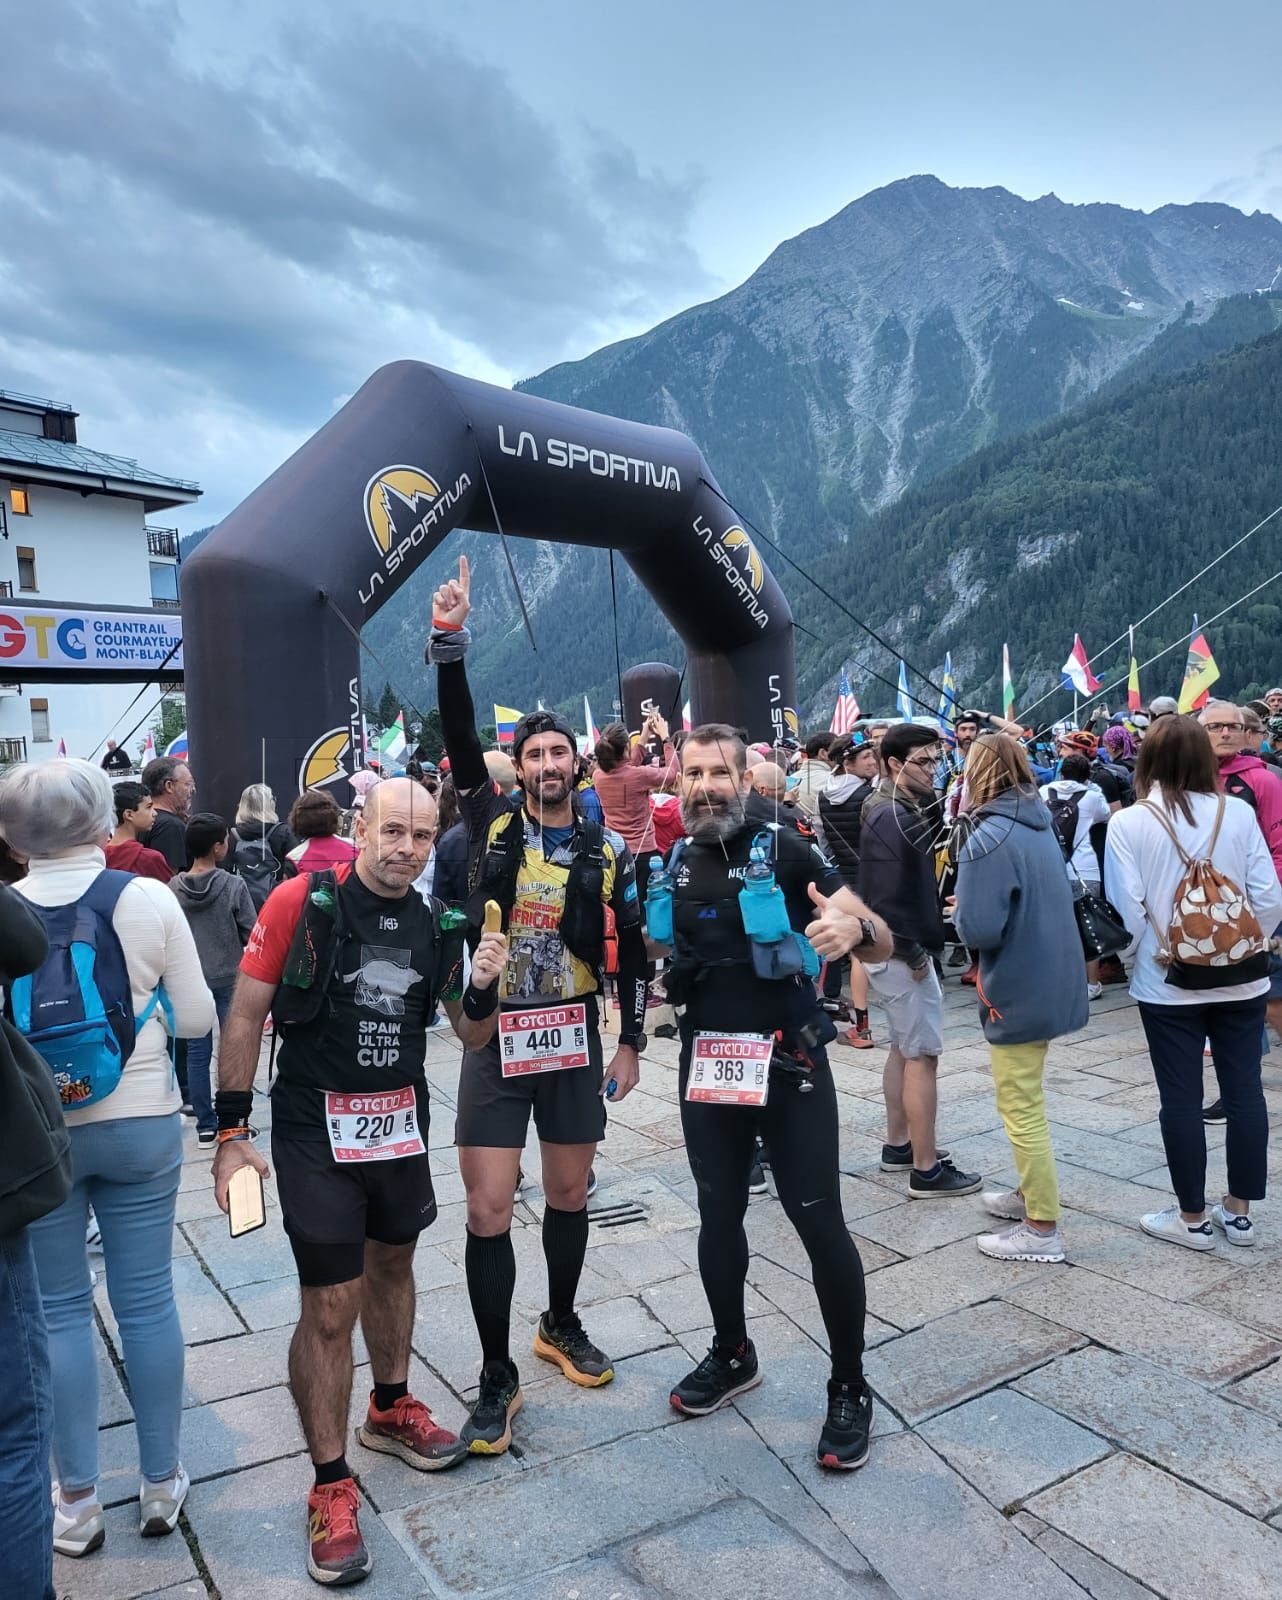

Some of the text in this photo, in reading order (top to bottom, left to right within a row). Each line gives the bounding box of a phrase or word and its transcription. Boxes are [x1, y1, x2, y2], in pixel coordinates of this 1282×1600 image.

[498, 425, 681, 492] LA SPORTIVA
[358, 472, 471, 604] LA SPORTIVA
[692, 515, 769, 629] LA SPORTIVA
[0, 614, 87, 660] GTC
[93, 620, 167, 634] GRANTRAIL
[96, 647, 180, 660] MONT-BLANC
[768, 675, 781, 703] LA
[348, 677, 362, 771] RTIVA
[634, 977, 646, 1015] TERREX
[358, 1020, 401, 1034] SPAIN
[526, 1028, 562, 1051] 440
[358, 1034, 400, 1047] ULTRA
[357, 1048, 400, 1067] CUP
[714, 1060, 744, 1082] 363
[355, 1114, 395, 1140] 220
